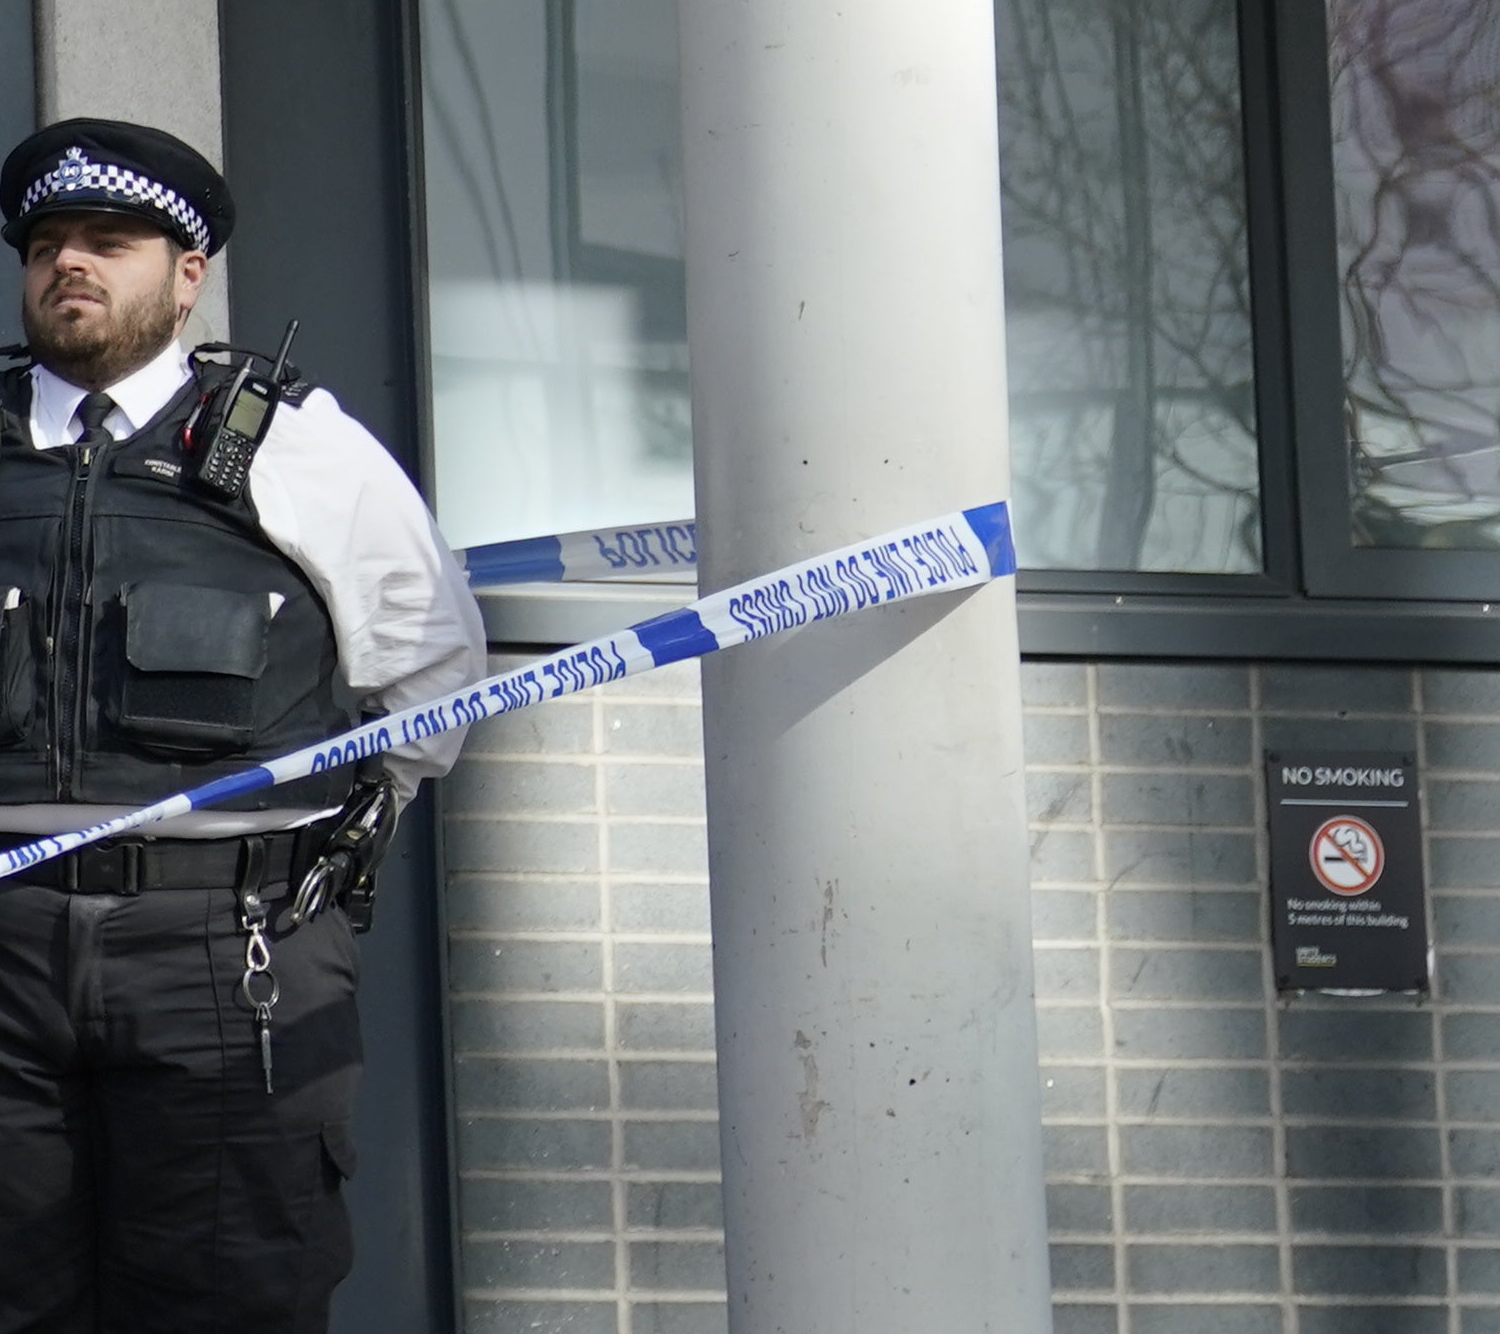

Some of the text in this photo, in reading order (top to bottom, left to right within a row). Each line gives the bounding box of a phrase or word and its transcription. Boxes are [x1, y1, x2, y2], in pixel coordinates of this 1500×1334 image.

[728, 524, 980, 643] POLICE LINE DO NOT CROSS
[543, 640, 628, 699] POLICE
[1282, 767, 1405, 788] NO SMOKING
[1287, 899, 1304, 911] No
